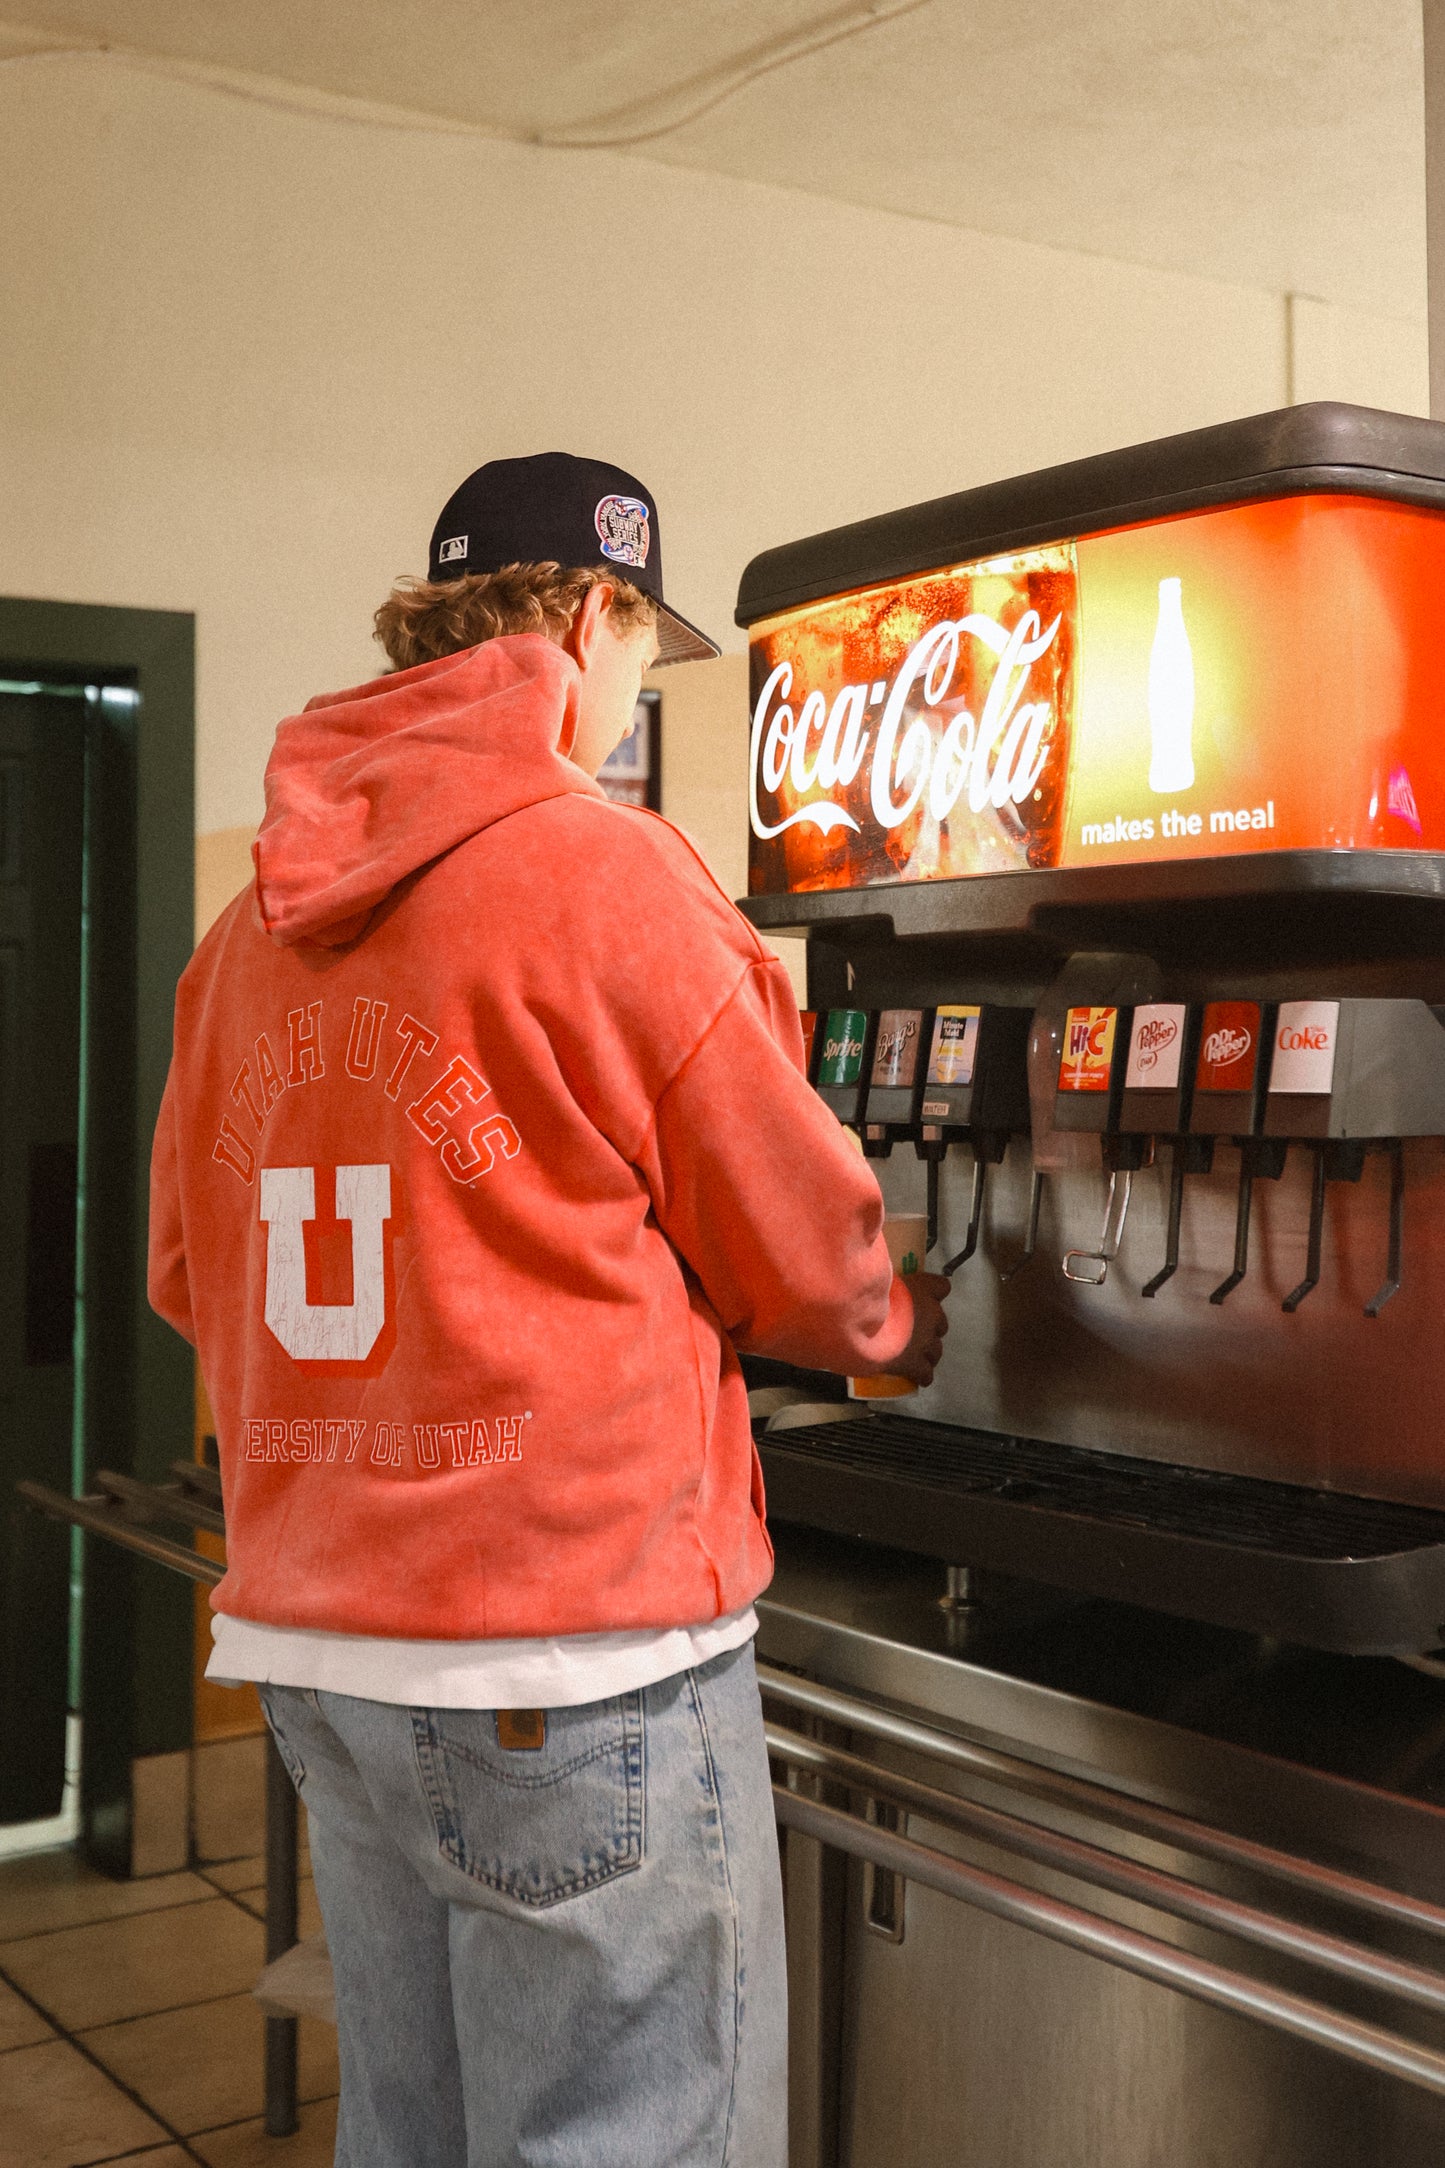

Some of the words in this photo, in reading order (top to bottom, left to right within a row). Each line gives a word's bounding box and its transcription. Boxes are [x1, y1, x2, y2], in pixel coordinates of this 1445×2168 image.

[750, 610, 1062, 840] Coca-Cola
[1081, 816, 1154, 845] makes
[1161, 809, 1202, 837] the
[1209, 800, 1274, 833] meal
[1139, 1025, 1174, 1050] Pepper
[1150, 1020, 1165, 1035] Dr
[1218, 1028, 1236, 1045] Dr
[1278, 1026, 1329, 1051] Coke
[823, 1038, 863, 1061] Sprite
[1205, 1033, 1247, 1062] Pepper
[212, 1000, 326, 1186] UTAH
[345, 997, 522, 1184] UTES
[260, 1163, 392, 1361] U
[243, 1418, 366, 1463] ERSITY
[371, 1421, 406, 1467] OF
